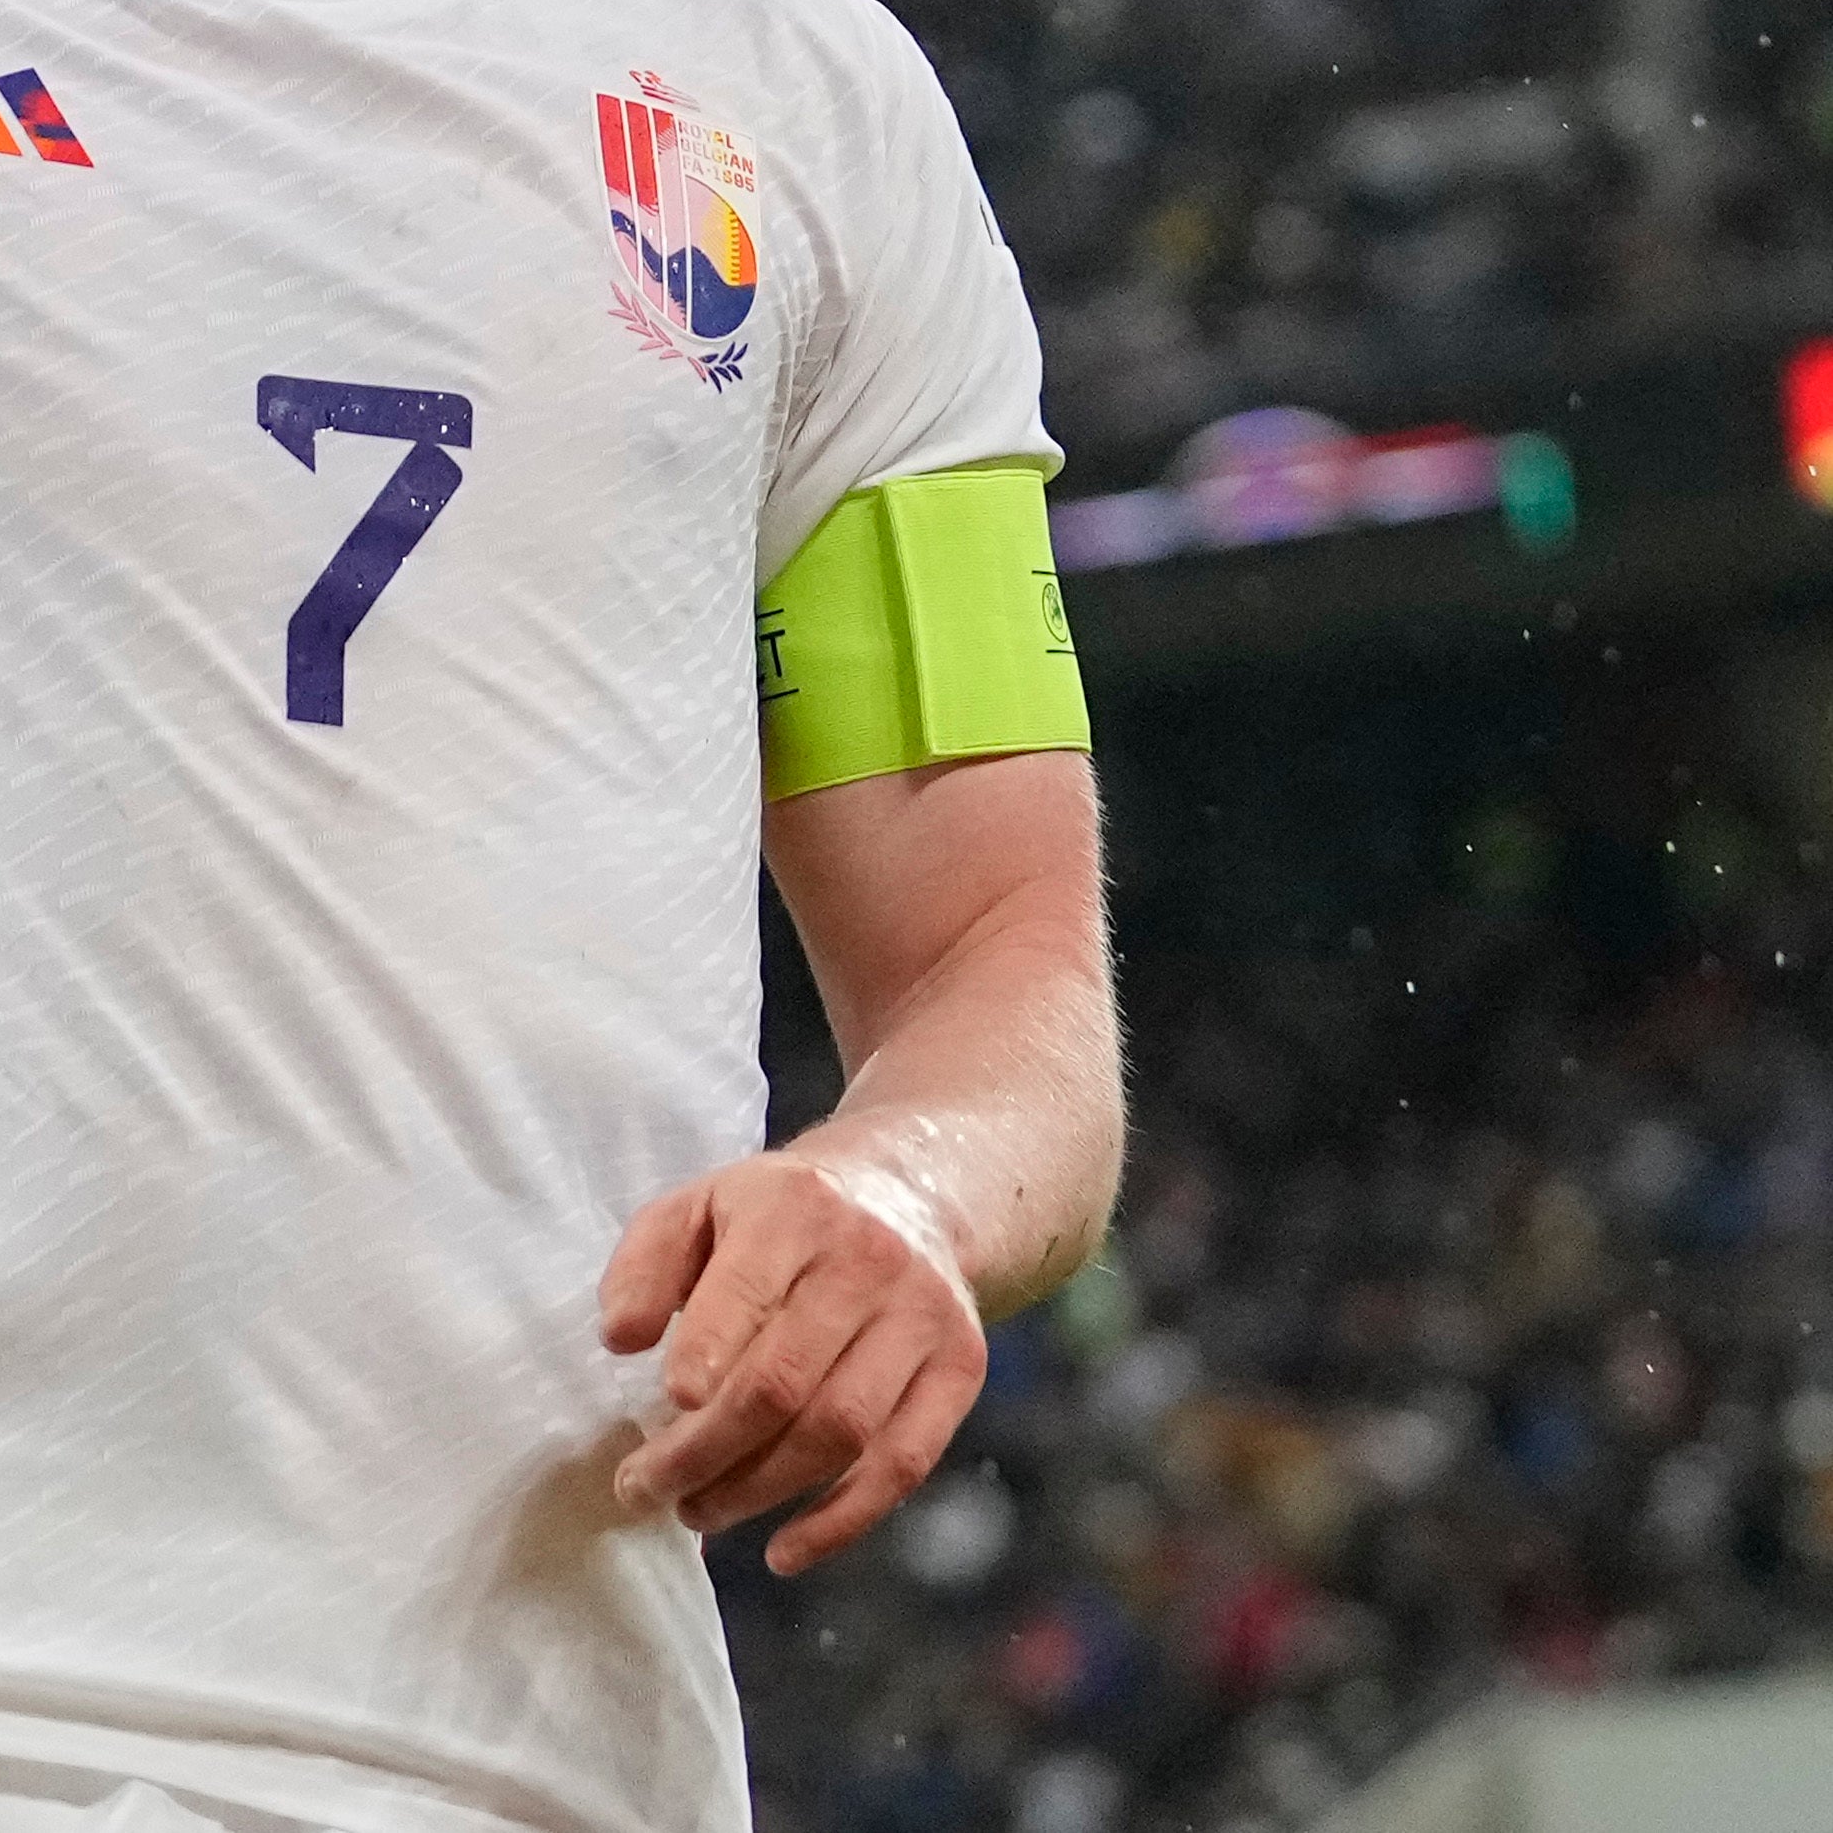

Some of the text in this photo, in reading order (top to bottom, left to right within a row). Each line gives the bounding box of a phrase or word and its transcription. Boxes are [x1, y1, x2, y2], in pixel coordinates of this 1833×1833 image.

[678, 119, 734, 149] ROYAL
[680, 138, 754, 175] BELGIAN
[257, 375, 473, 726] 7
